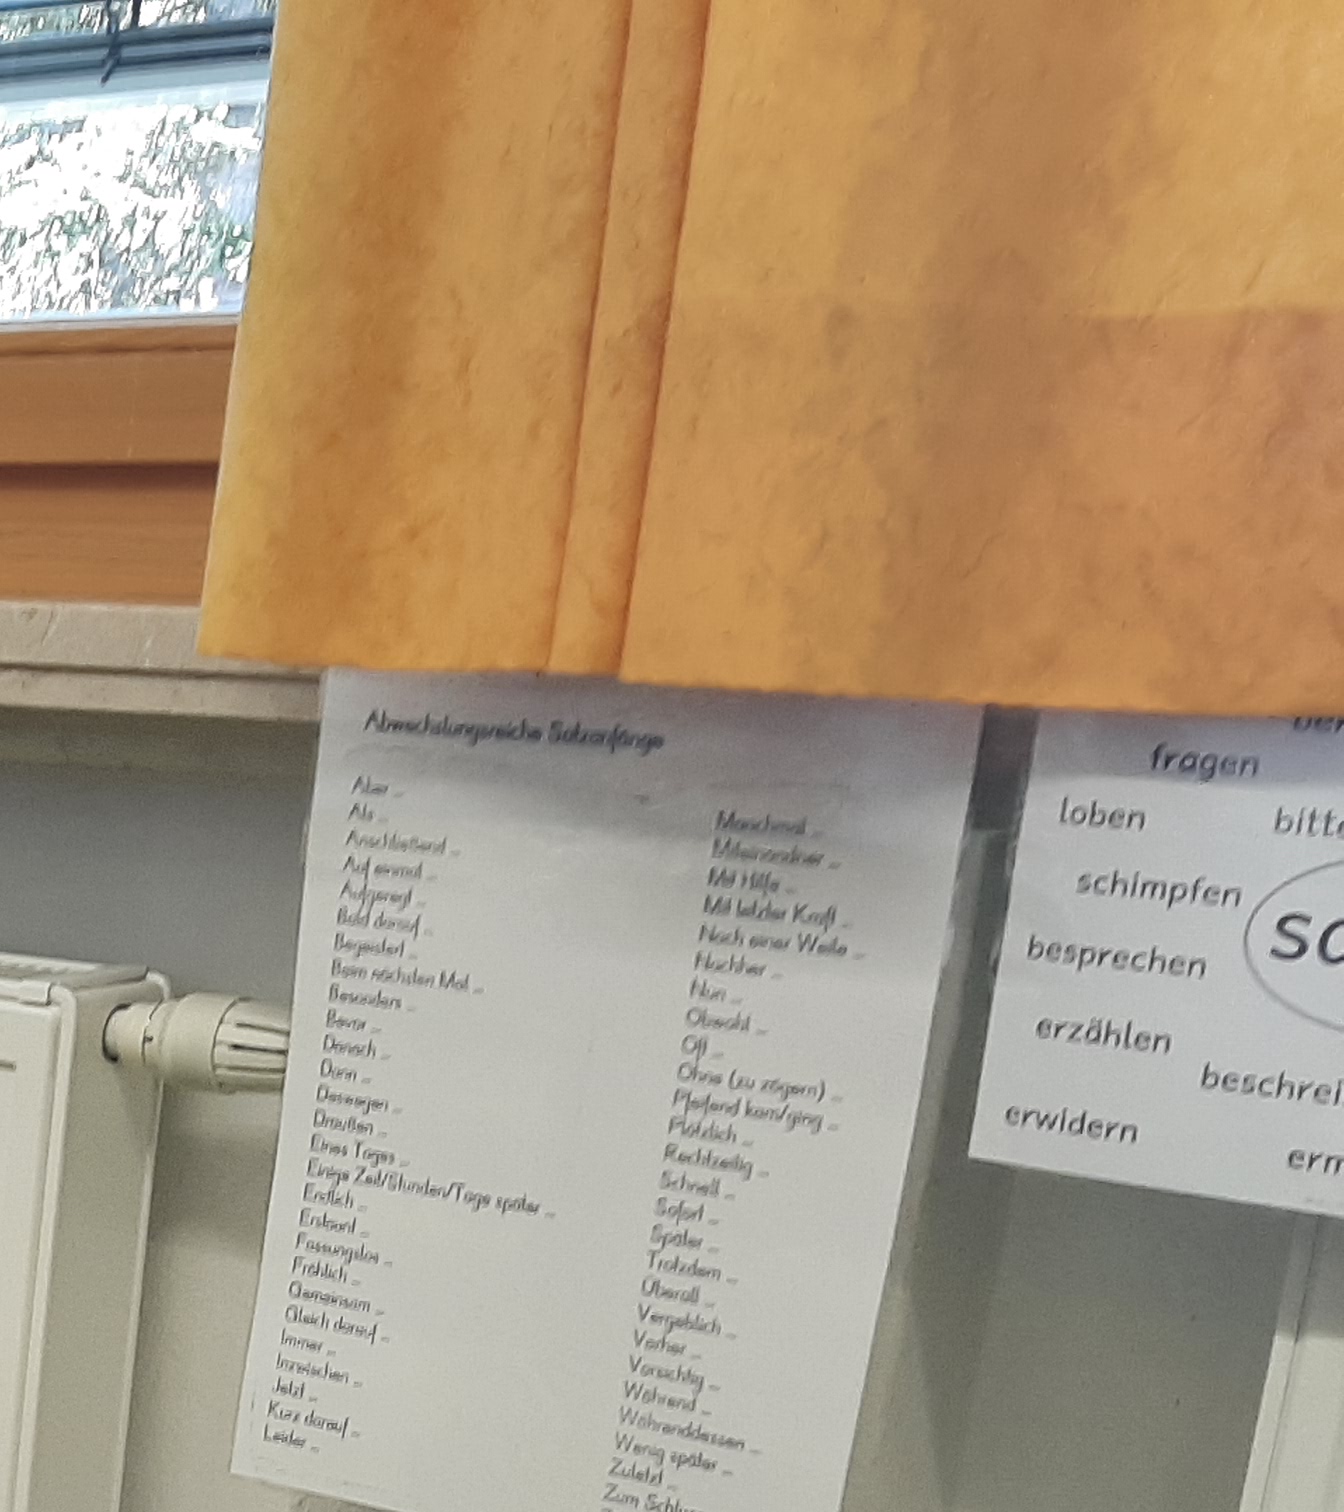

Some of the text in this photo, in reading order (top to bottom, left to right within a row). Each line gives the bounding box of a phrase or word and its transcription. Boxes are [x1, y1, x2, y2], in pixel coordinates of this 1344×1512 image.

[1150, 743, 1260, 781] fragen
[1058, 797, 1147, 832] loben
[1075, 870, 1244, 909] schimpfen
[1026, 934, 1208, 980] besprechen
[1035, 1015, 1173, 1055] erzählen
[1004, 1103, 1140, 1144] erwidern
